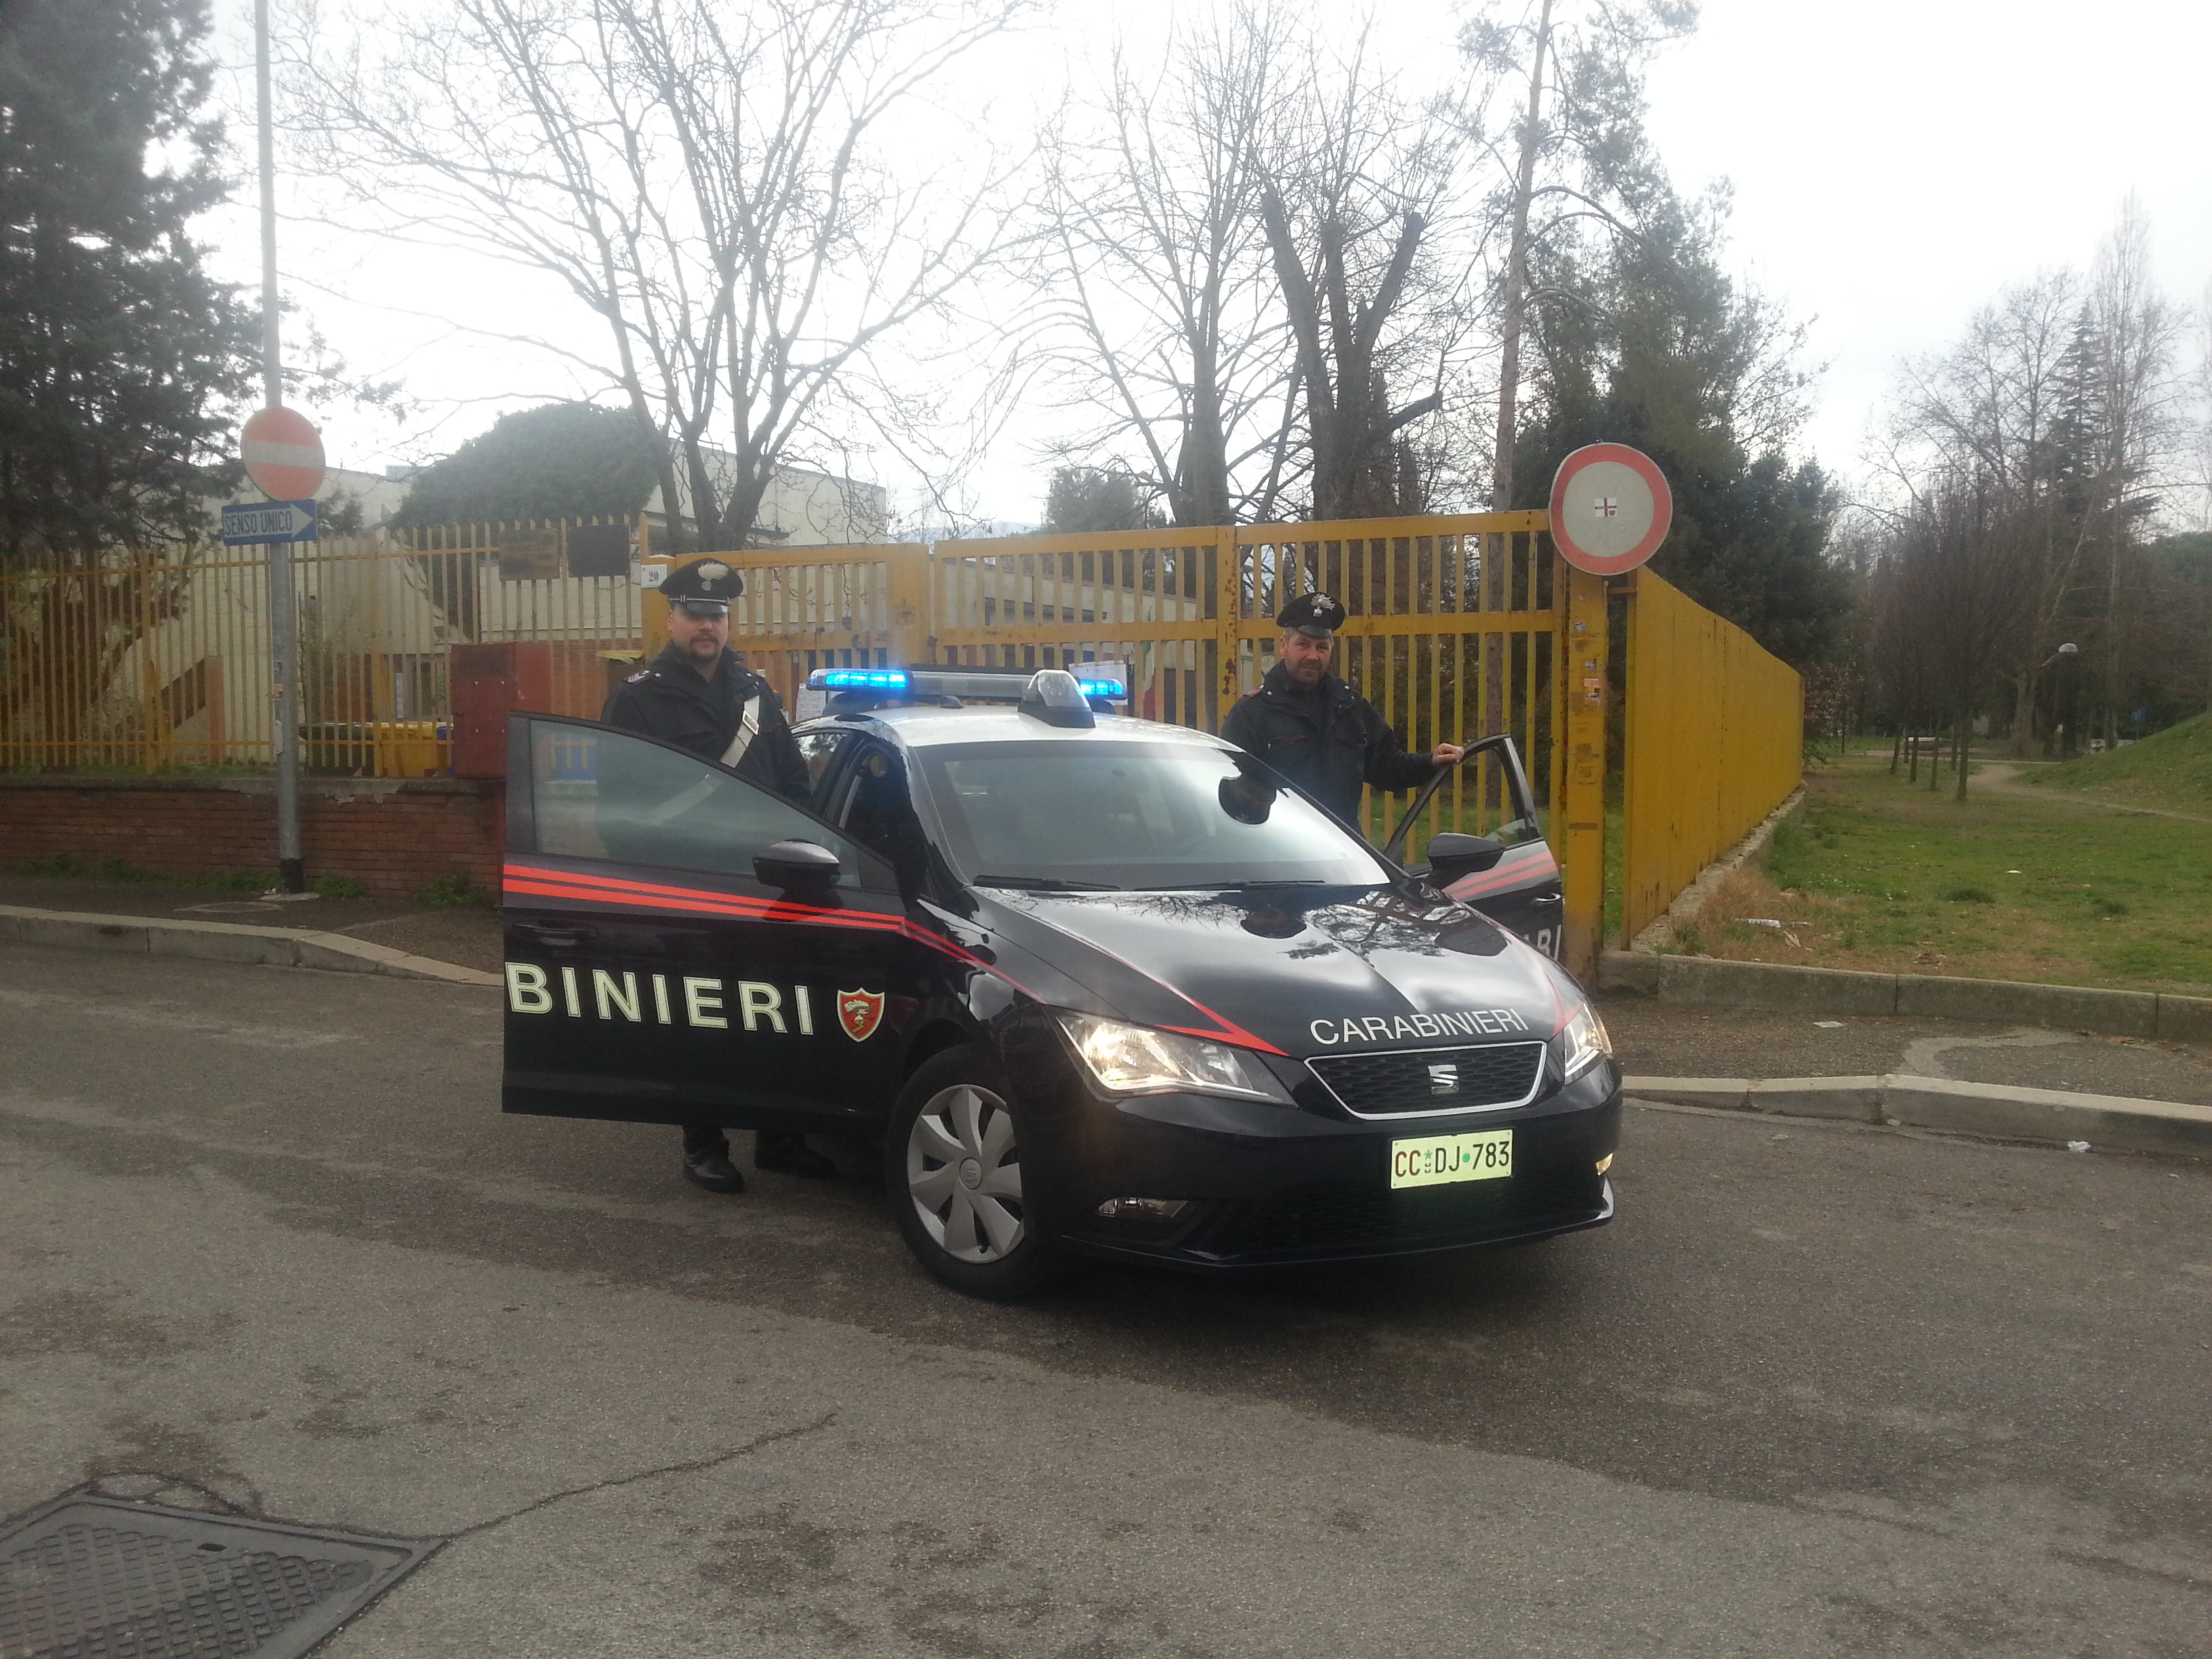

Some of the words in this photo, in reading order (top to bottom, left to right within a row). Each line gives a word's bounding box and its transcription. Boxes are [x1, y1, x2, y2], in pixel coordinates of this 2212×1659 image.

[224, 514, 258, 535] SENSO
[260, 510, 293, 533] UNICO
[649, 571, 659, 582] 20
[505, 961, 813, 1036] BINIERI
[1310, 1008, 1529, 1044] CARABINIERI
